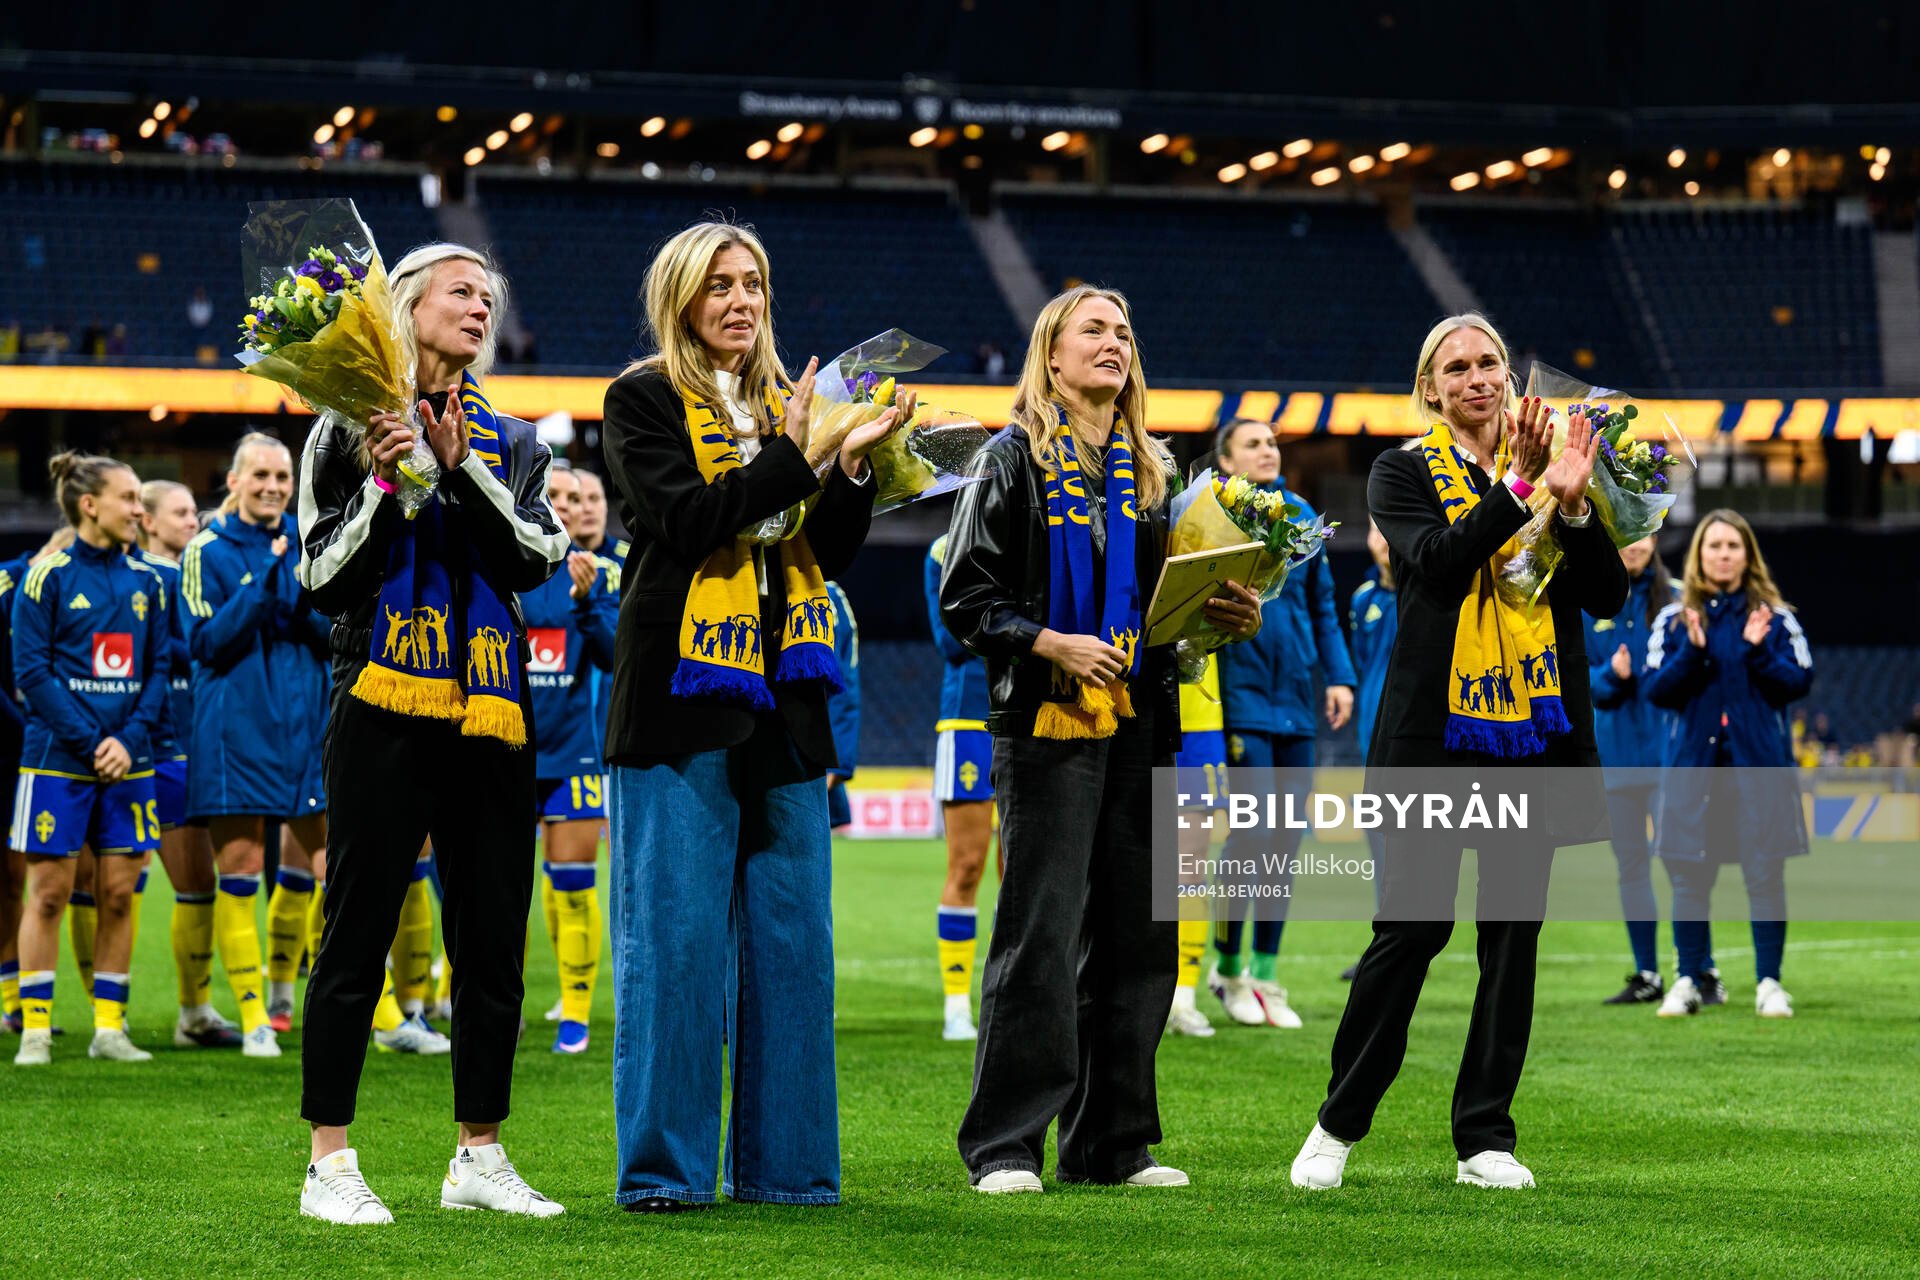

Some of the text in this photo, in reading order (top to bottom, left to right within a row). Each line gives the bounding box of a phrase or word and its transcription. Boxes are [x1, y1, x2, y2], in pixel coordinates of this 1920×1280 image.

[740, 91, 902, 121] Strawberry Arena
[951, 99, 1002, 122] Room
[68, 678, 126, 693] SVENSKA
